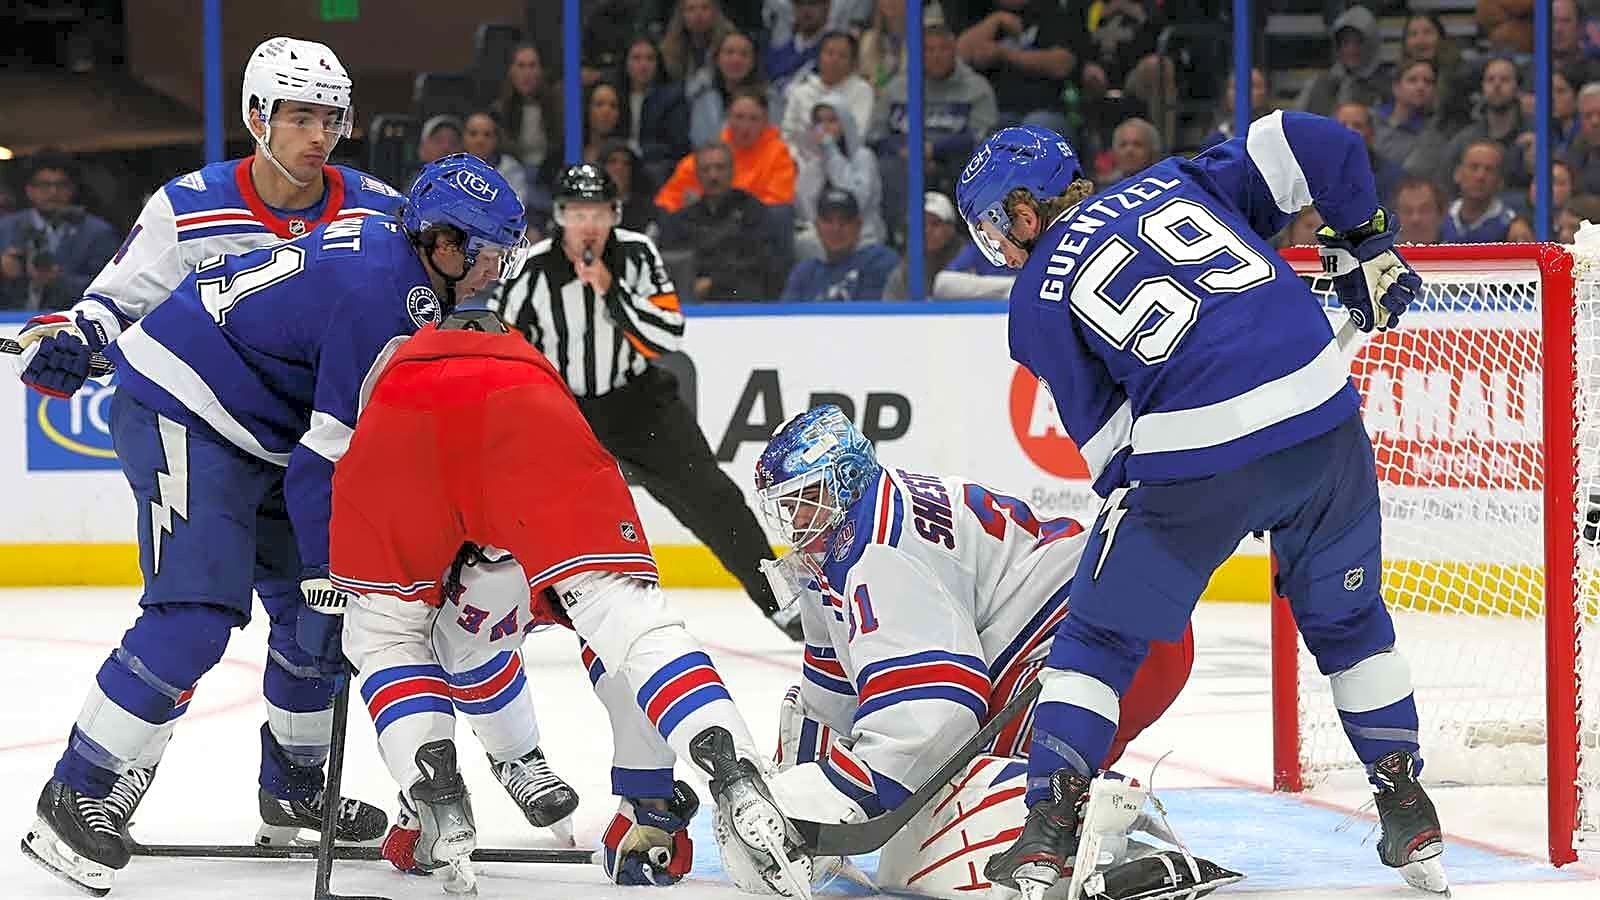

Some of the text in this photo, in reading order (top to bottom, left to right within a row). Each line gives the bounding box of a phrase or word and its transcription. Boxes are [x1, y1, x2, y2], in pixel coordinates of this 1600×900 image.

[462, 170, 498, 201] TGH
[962, 143, 992, 178] TGH
[1039, 177, 1182, 302] GUENTZEL
[195, 244, 306, 327] 1
[1069, 197, 1276, 366] 59
